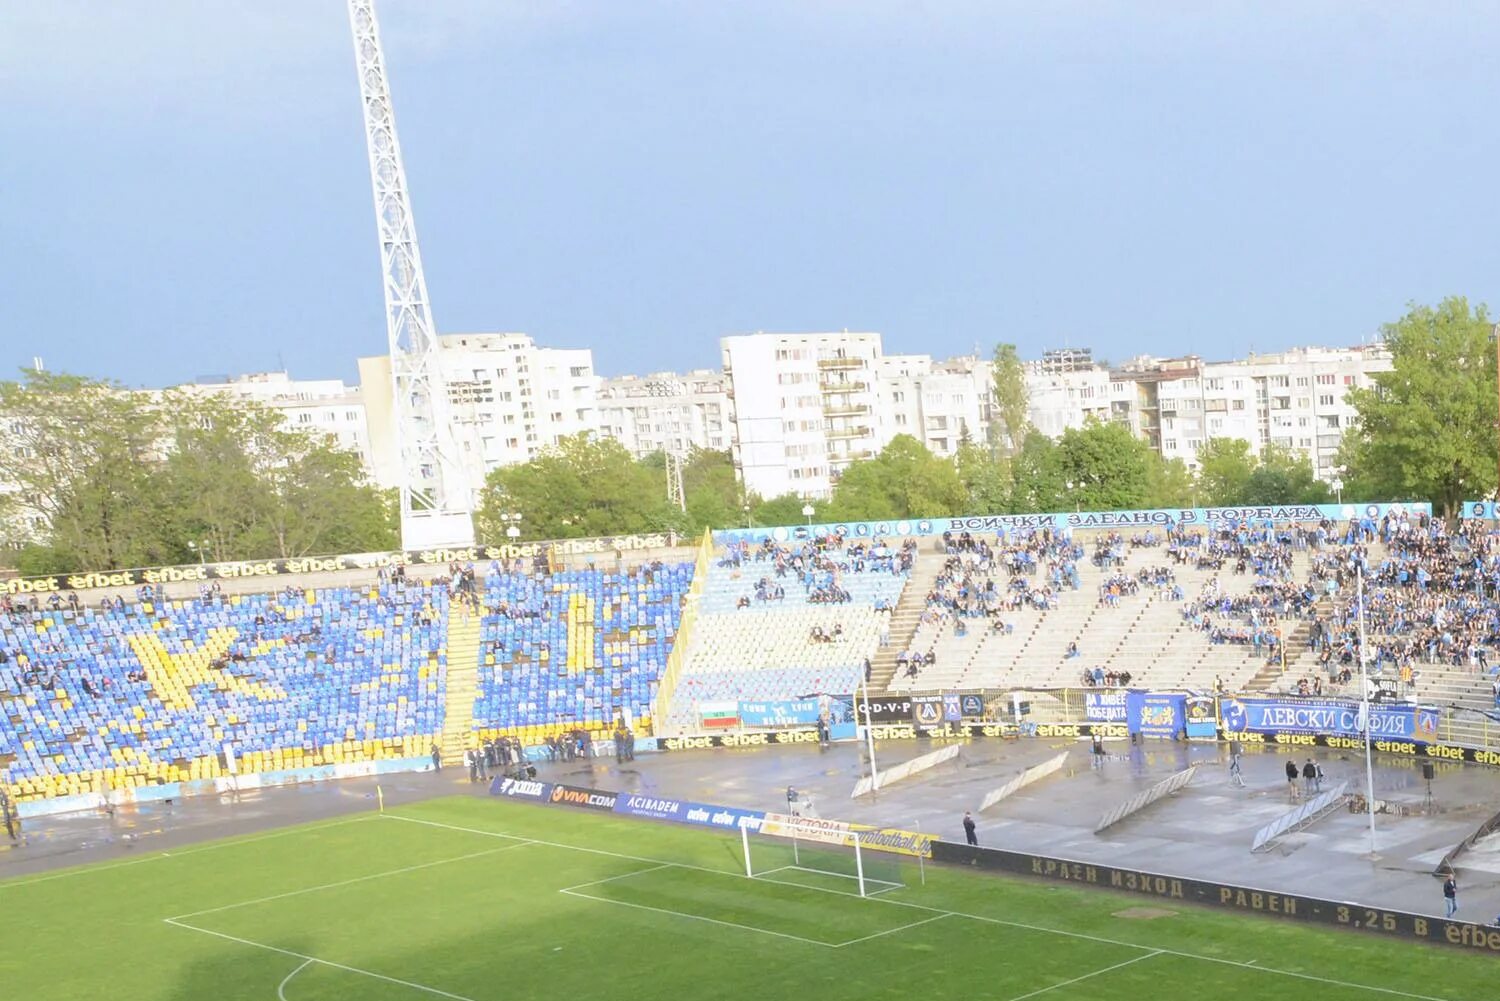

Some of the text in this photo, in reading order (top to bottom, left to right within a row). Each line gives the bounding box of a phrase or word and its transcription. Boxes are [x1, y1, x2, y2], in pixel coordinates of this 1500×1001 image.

[949, 514, 1056, 531] ВСИЧКИ
[1205, 505, 1325, 522] БОРБАТА
[551, 539, 607, 554] efbet
[613, 535, 666, 550] efbet
[420, 548, 478, 564] efbet
[485, 543, 542, 559] efbet
[216, 560, 278, 578] efbet
[286, 557, 345, 573] efbet
[69, 571, 135, 589] efbet
[144, 566, 208, 584] efbet
[1261, 706, 1335, 728] ЛЕВСКИ
[871, 726, 917, 739] efbet
[1038, 725, 1080, 737] efbet
[665, 735, 713, 750] efbet
[721, 732, 768, 747] efbet
[1274, 733, 1316, 747] efbet
[1375, 740, 1417, 754] efbet
[1425, 744, 1465, 760] efbet
[563, 790, 616, 808] VIVACOM
[627, 796, 679, 813] ACIBADEM
[1031, 858, 1097, 883] КРАЕН
[1111, 870, 1184, 898] ИЗХОД
[1220, 887, 1296, 914] РАВЕН
